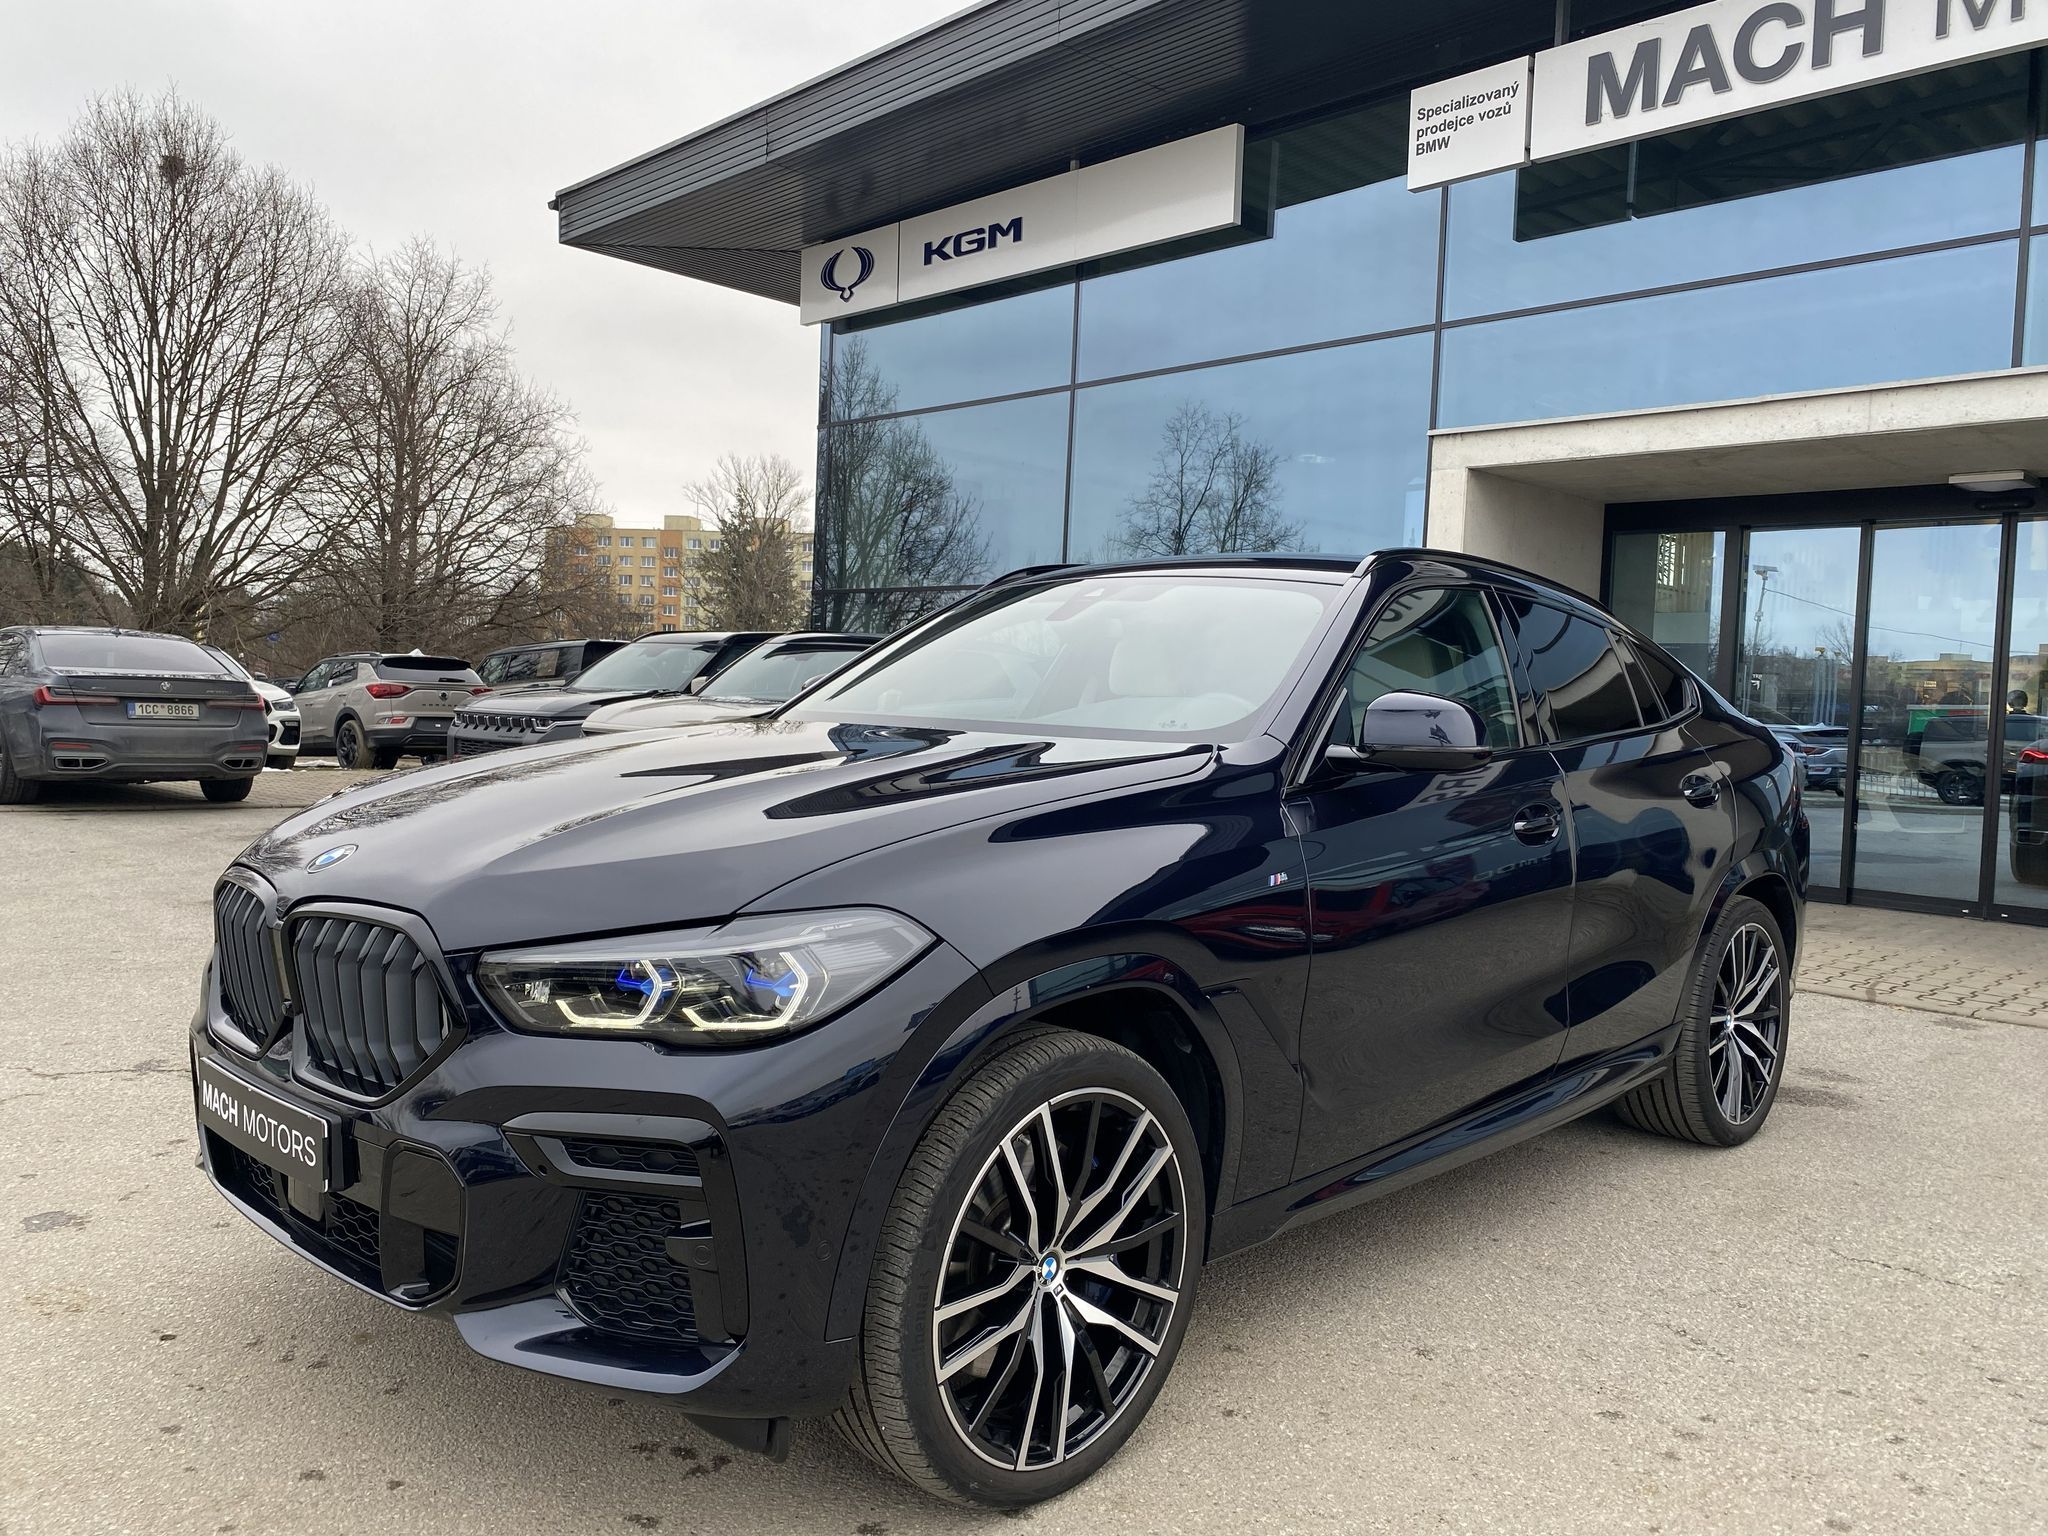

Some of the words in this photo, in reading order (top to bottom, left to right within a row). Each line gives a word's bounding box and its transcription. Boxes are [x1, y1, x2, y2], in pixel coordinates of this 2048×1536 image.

[1585, 0, 1884, 126] MACH
[1416, 115, 1475, 141] prodejce
[1478, 101, 1512, 121] vozů
[1417, 81, 1519, 121] Specializovaný
[1416, 135, 1451, 156] BMW
[923, 216, 1023, 266] KGM
[138, 703, 159, 715] 1CC
[167, 705, 194, 716] 8866
[202, 1079, 238, 1127] MACH
[243, 1104, 317, 1167] MOTORS
